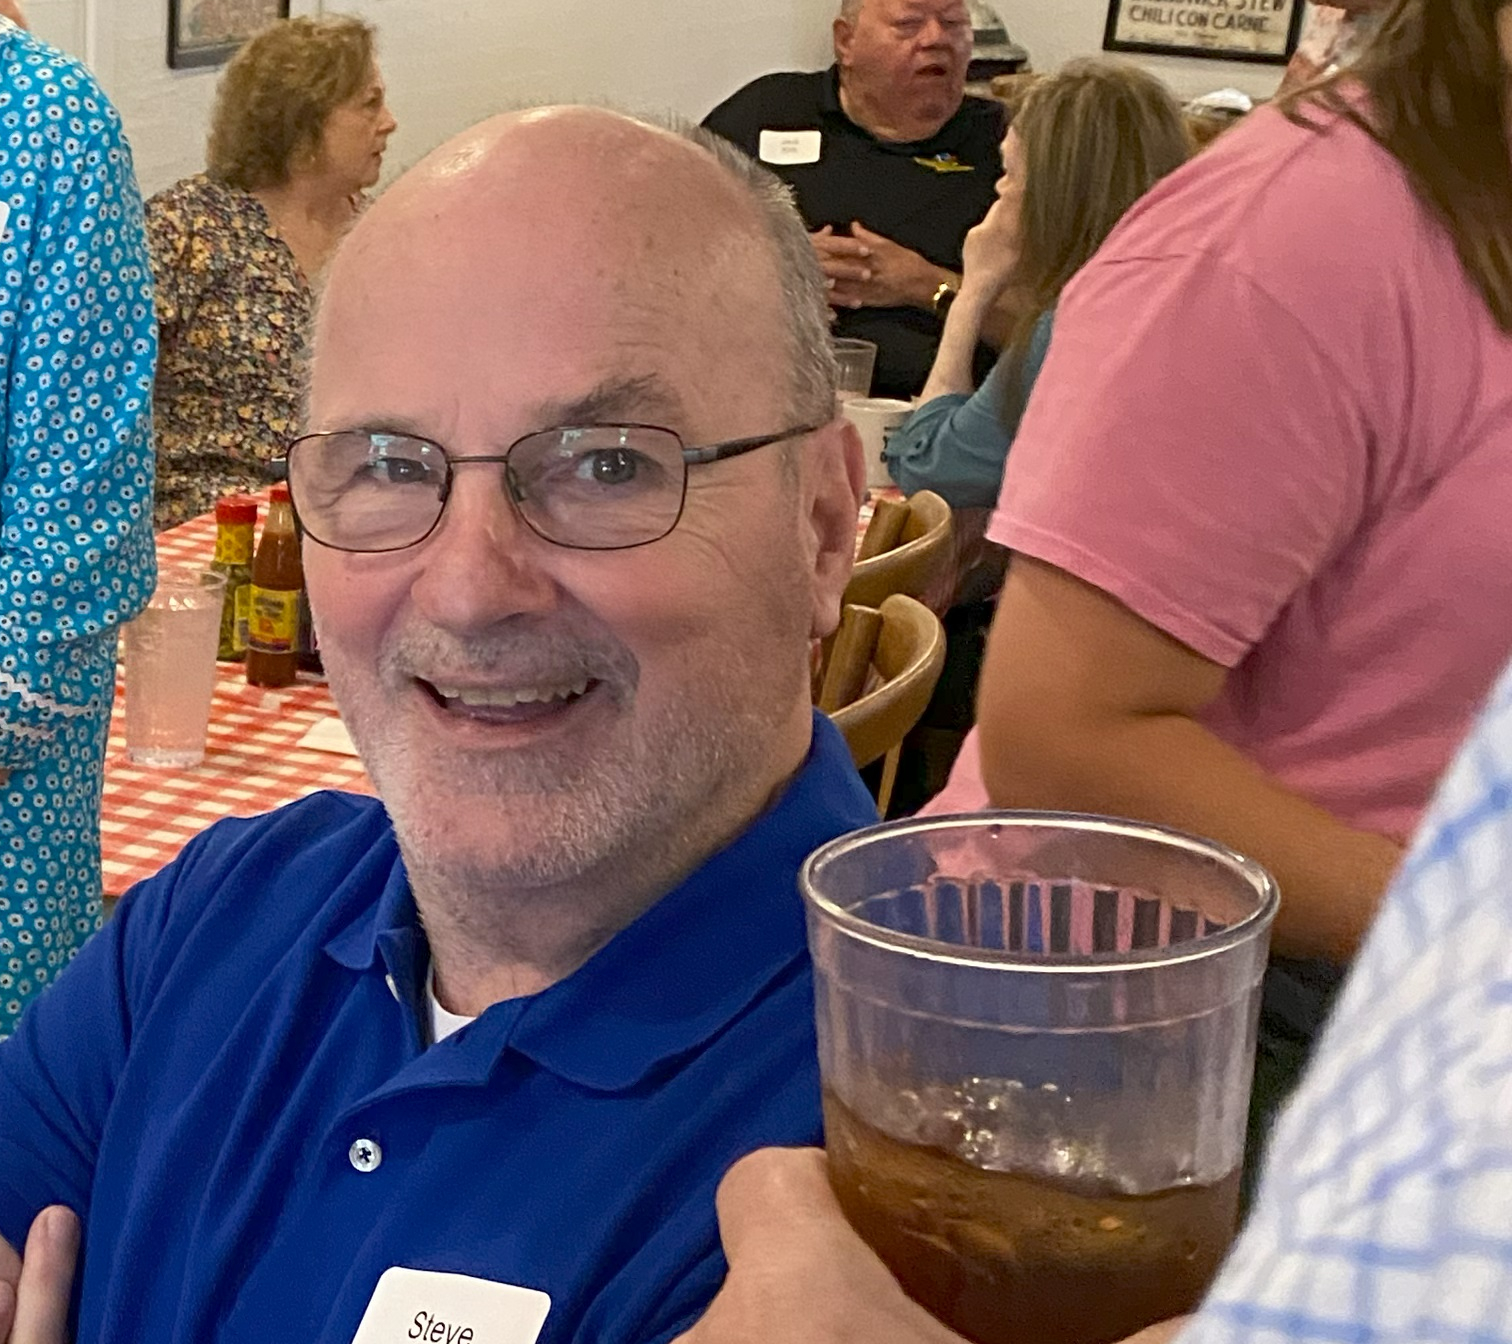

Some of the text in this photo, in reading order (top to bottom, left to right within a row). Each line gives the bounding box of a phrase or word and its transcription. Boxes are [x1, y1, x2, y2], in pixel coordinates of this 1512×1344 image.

[1129, 4, 1271, 33] CHILI CON CARNE
